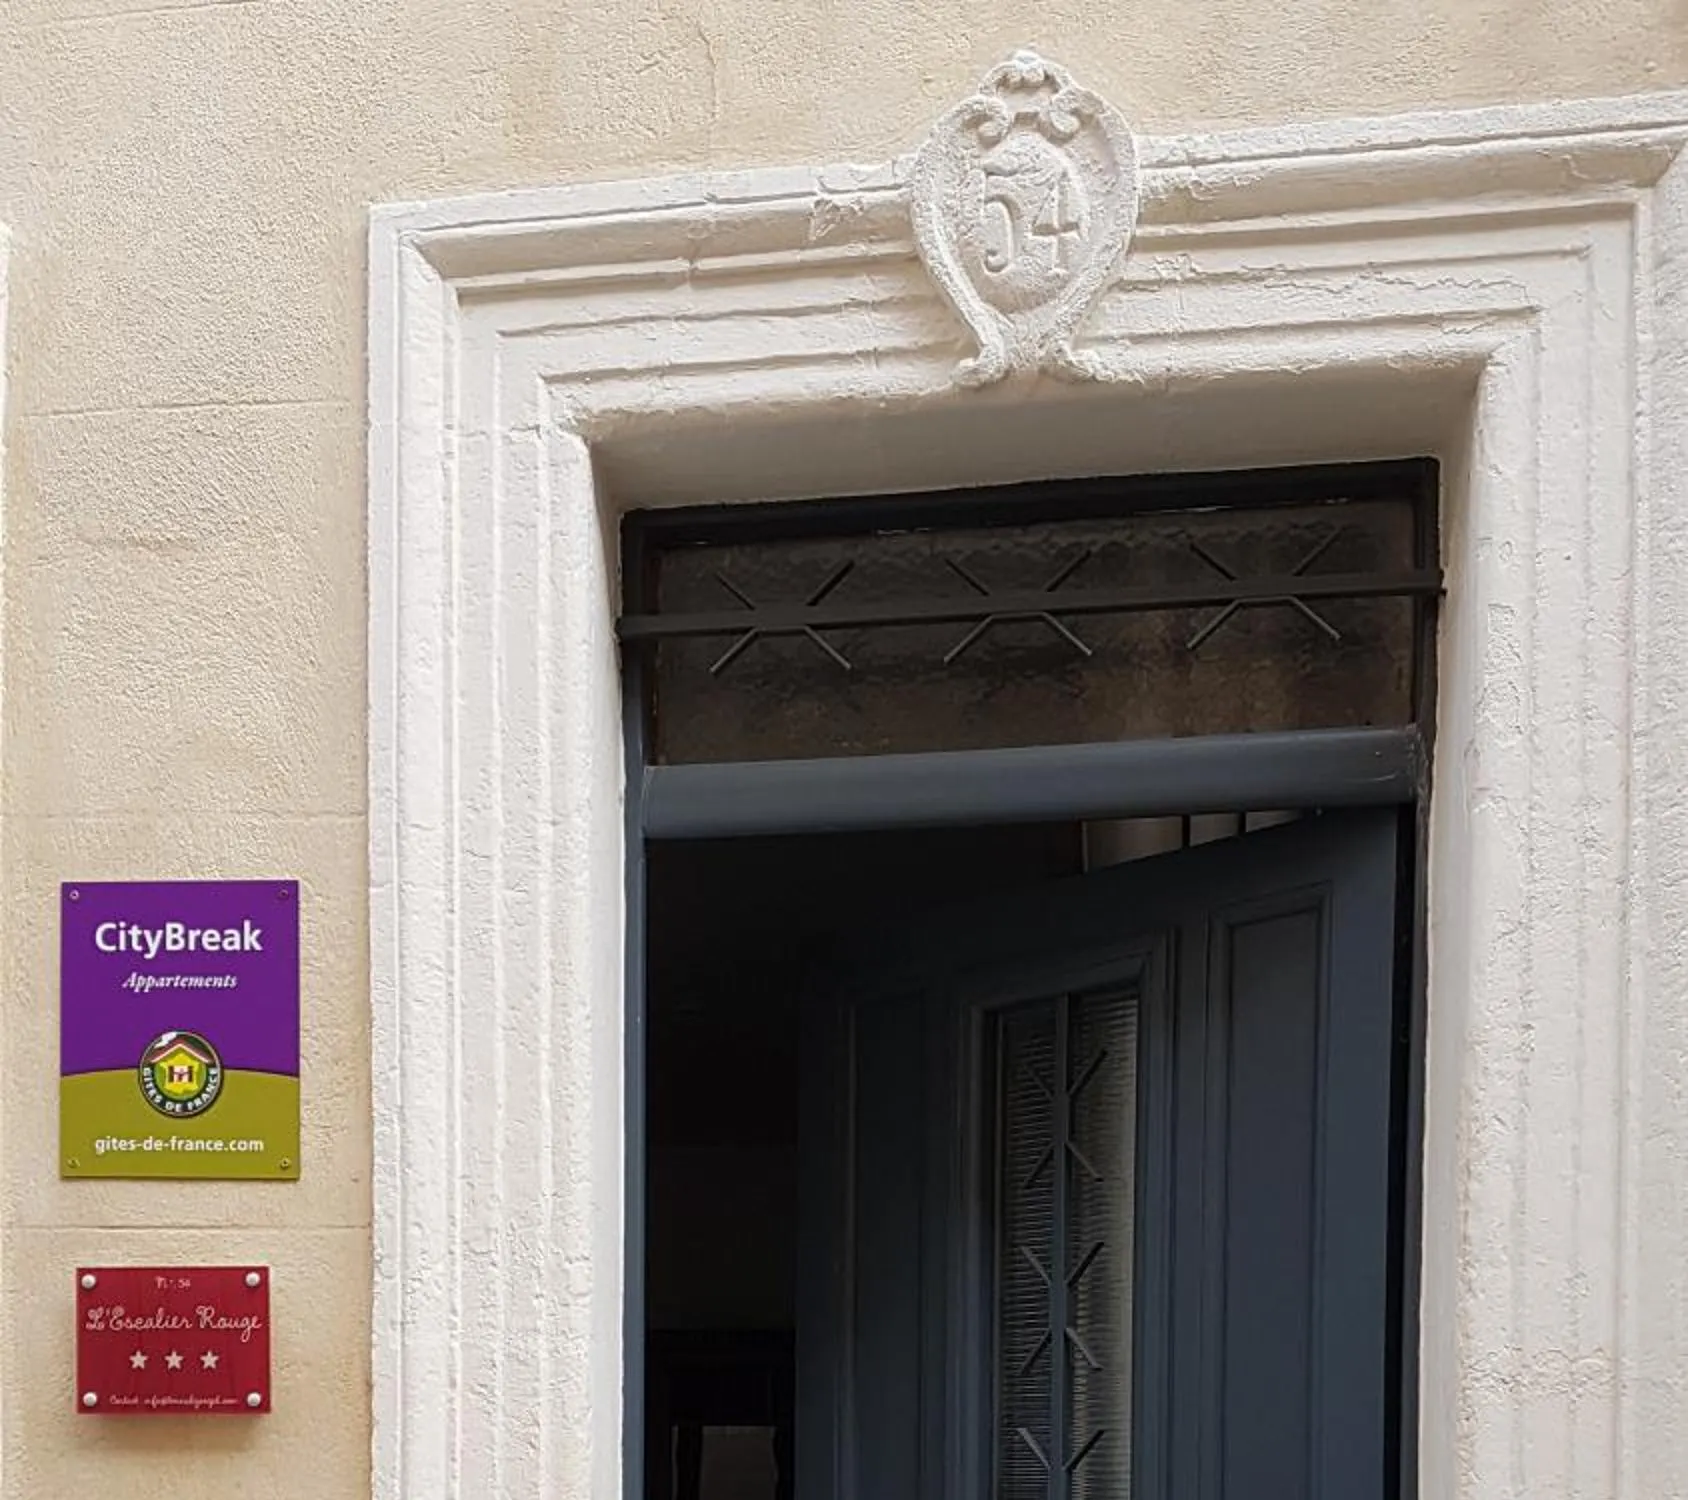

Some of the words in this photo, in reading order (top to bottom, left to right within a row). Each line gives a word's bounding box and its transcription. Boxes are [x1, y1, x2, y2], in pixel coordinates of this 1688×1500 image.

[95, 920, 262, 959] CityBreak
[121, 971, 238, 992] Appartements
[187, 1067, 218, 1111] FRANCE
[95, 1135, 264, 1154] gites-de-france.com
[85, 1306, 192, 1331] L'Escalier
[196, 1305, 262, 1343] Rouge
